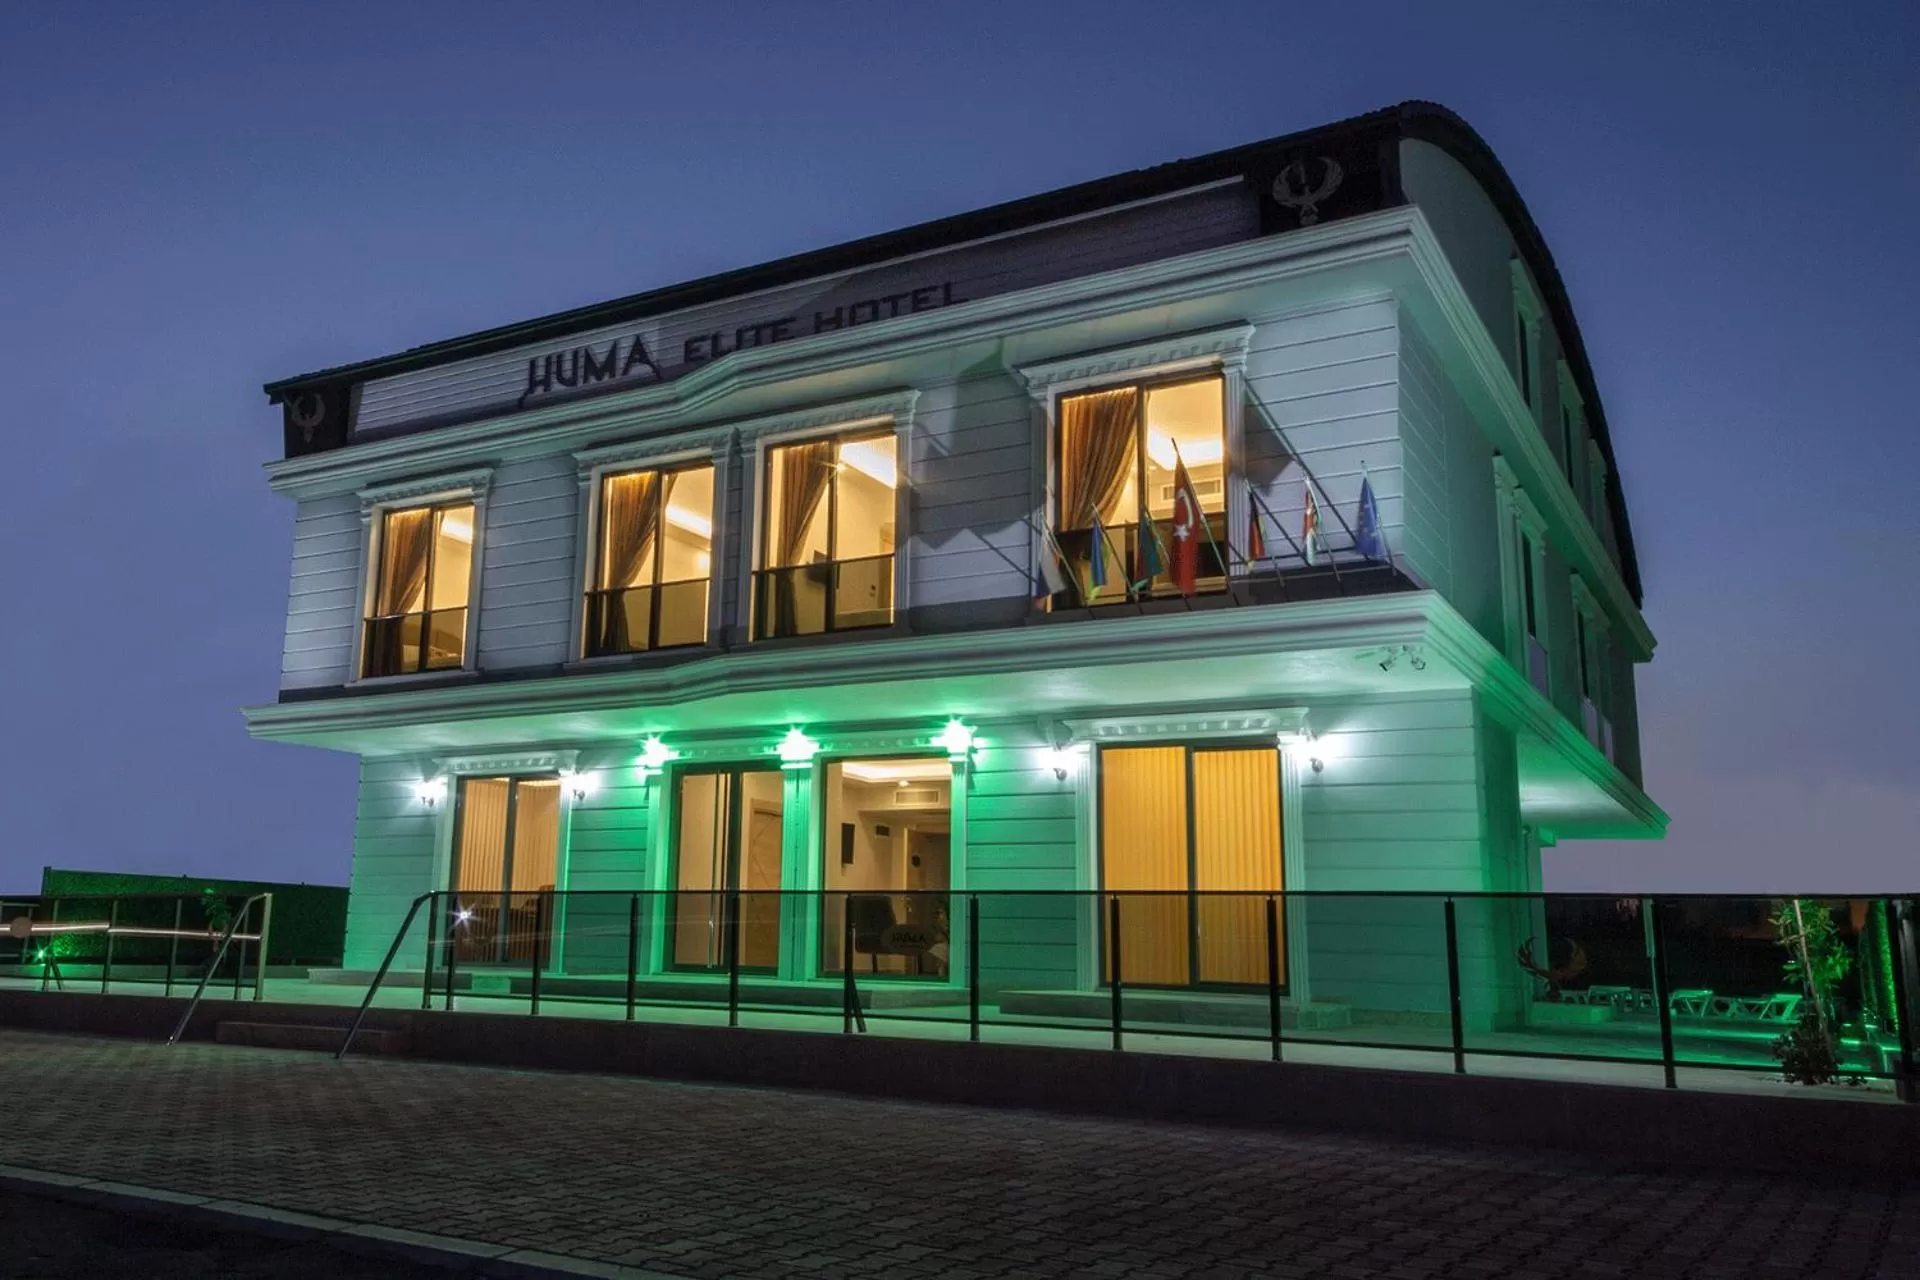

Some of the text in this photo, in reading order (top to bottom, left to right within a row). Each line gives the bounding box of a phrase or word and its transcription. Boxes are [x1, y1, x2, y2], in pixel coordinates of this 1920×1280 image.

[519, 282, 968, 409] HUMA ELITE HOTEL
